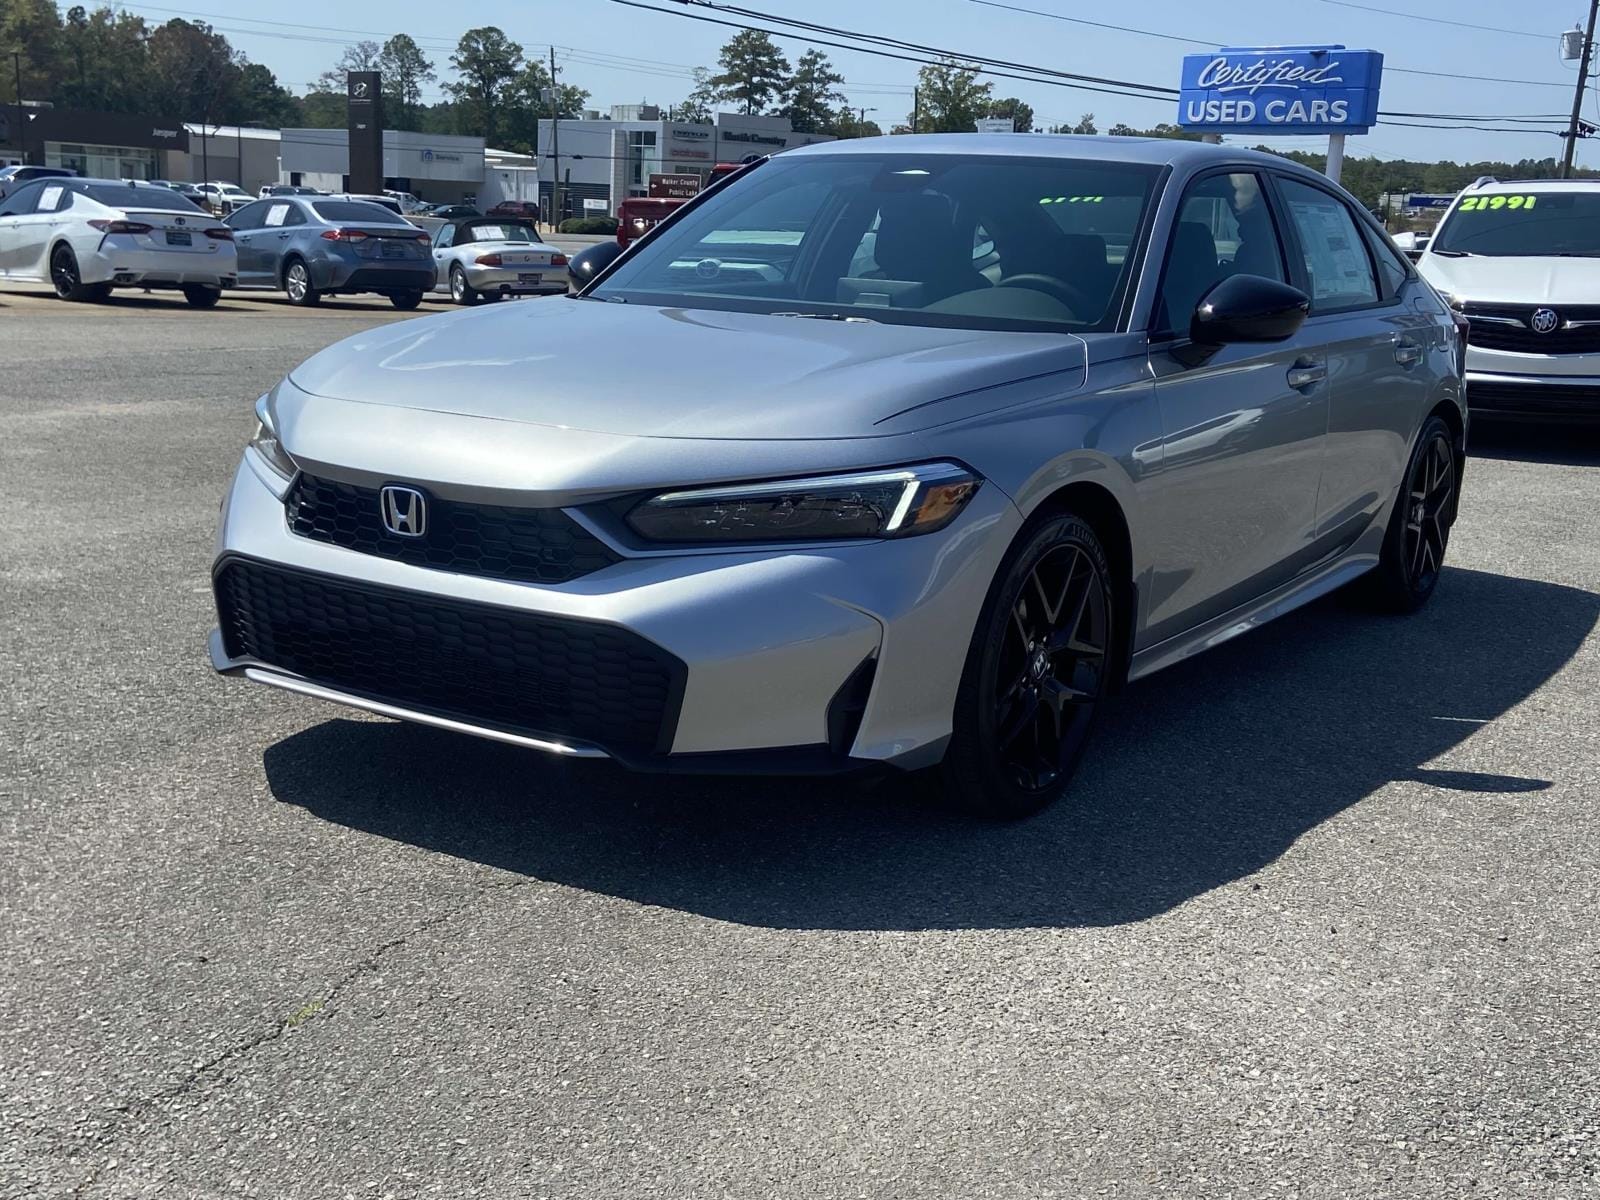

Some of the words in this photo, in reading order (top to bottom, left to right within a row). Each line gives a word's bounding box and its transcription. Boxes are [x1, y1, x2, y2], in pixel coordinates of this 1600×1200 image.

[1198, 57, 1343, 94] Certified
[1187, 100, 1257, 122] USED
[1264, 100, 1349, 122] CARS
[680, 179, 698, 187] County
[669, 188, 685, 196] Public
[1458, 195, 1537, 211] 21991
